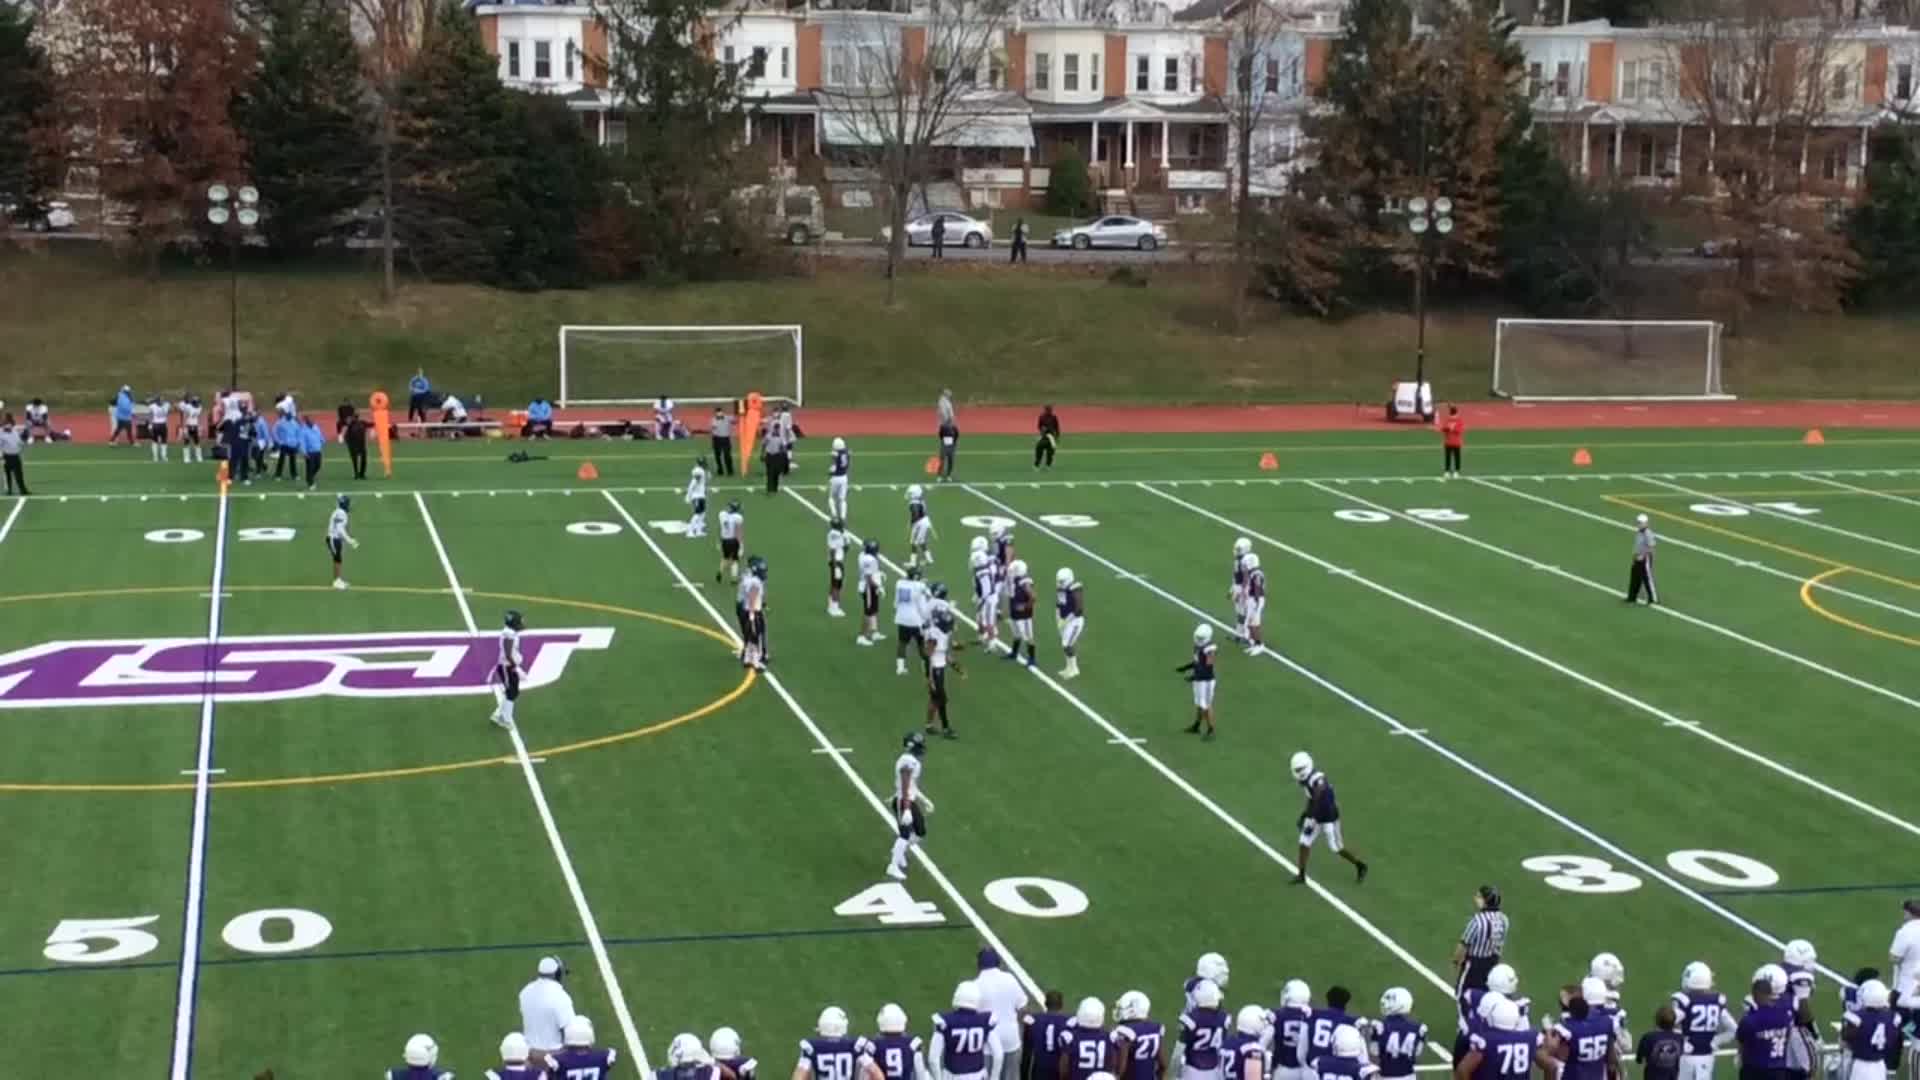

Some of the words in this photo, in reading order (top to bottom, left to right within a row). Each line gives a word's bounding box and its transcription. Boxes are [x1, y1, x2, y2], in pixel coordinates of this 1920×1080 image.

[1690, 1004, 1720, 1032] 28
[951, 1027, 984, 1053] 70
[1045, 1024, 1055, 1051] 1
[1134, 1033, 1161, 1059] 27
[1193, 1027, 1223, 1051] 24
[1314, 1019, 1333, 1047] 6
[1385, 1031, 1417, 1058] 44
[1871, 1022, 1886, 1050] 4
[816, 1052, 854, 1080] 50
[885, 1048, 904, 1077] 9
[1078, 1040, 1106, 1069] 51
[1496, 1042, 1531, 1074] 78
